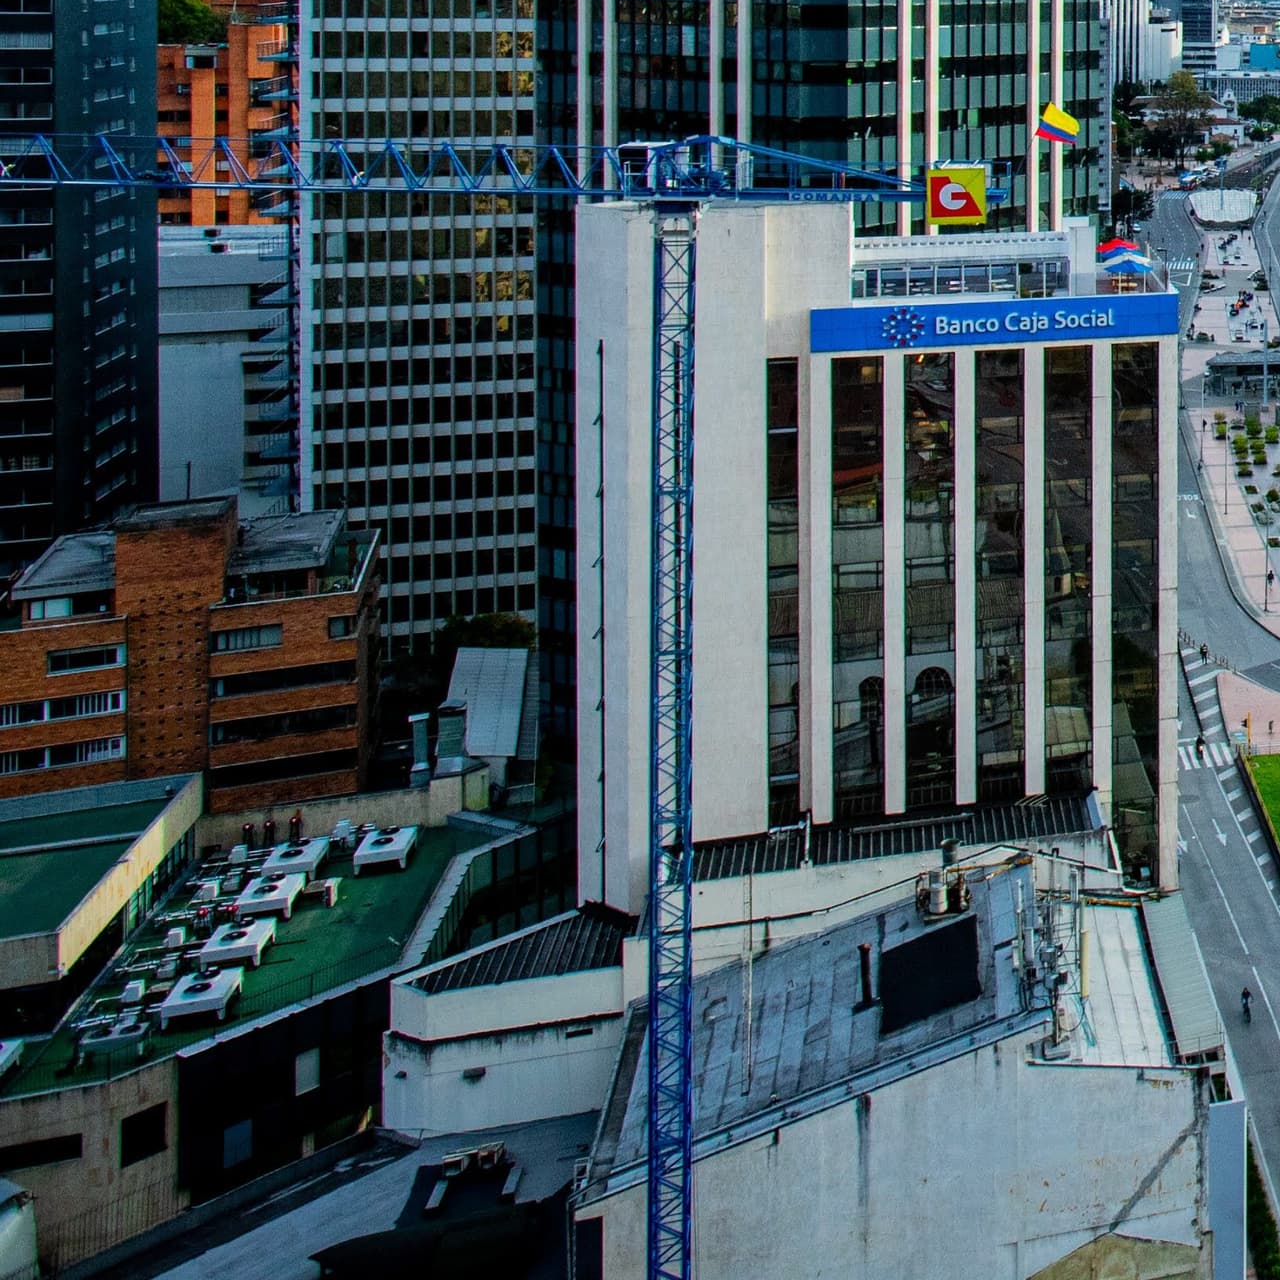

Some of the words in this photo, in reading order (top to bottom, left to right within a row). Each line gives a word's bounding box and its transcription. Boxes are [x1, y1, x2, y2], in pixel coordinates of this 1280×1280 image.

[791, 192, 874, 201] COMANSA
[935, 314, 999, 336] Banco
[1004, 311, 1050, 333] Caja
[1054, 308, 1115, 330] Social
